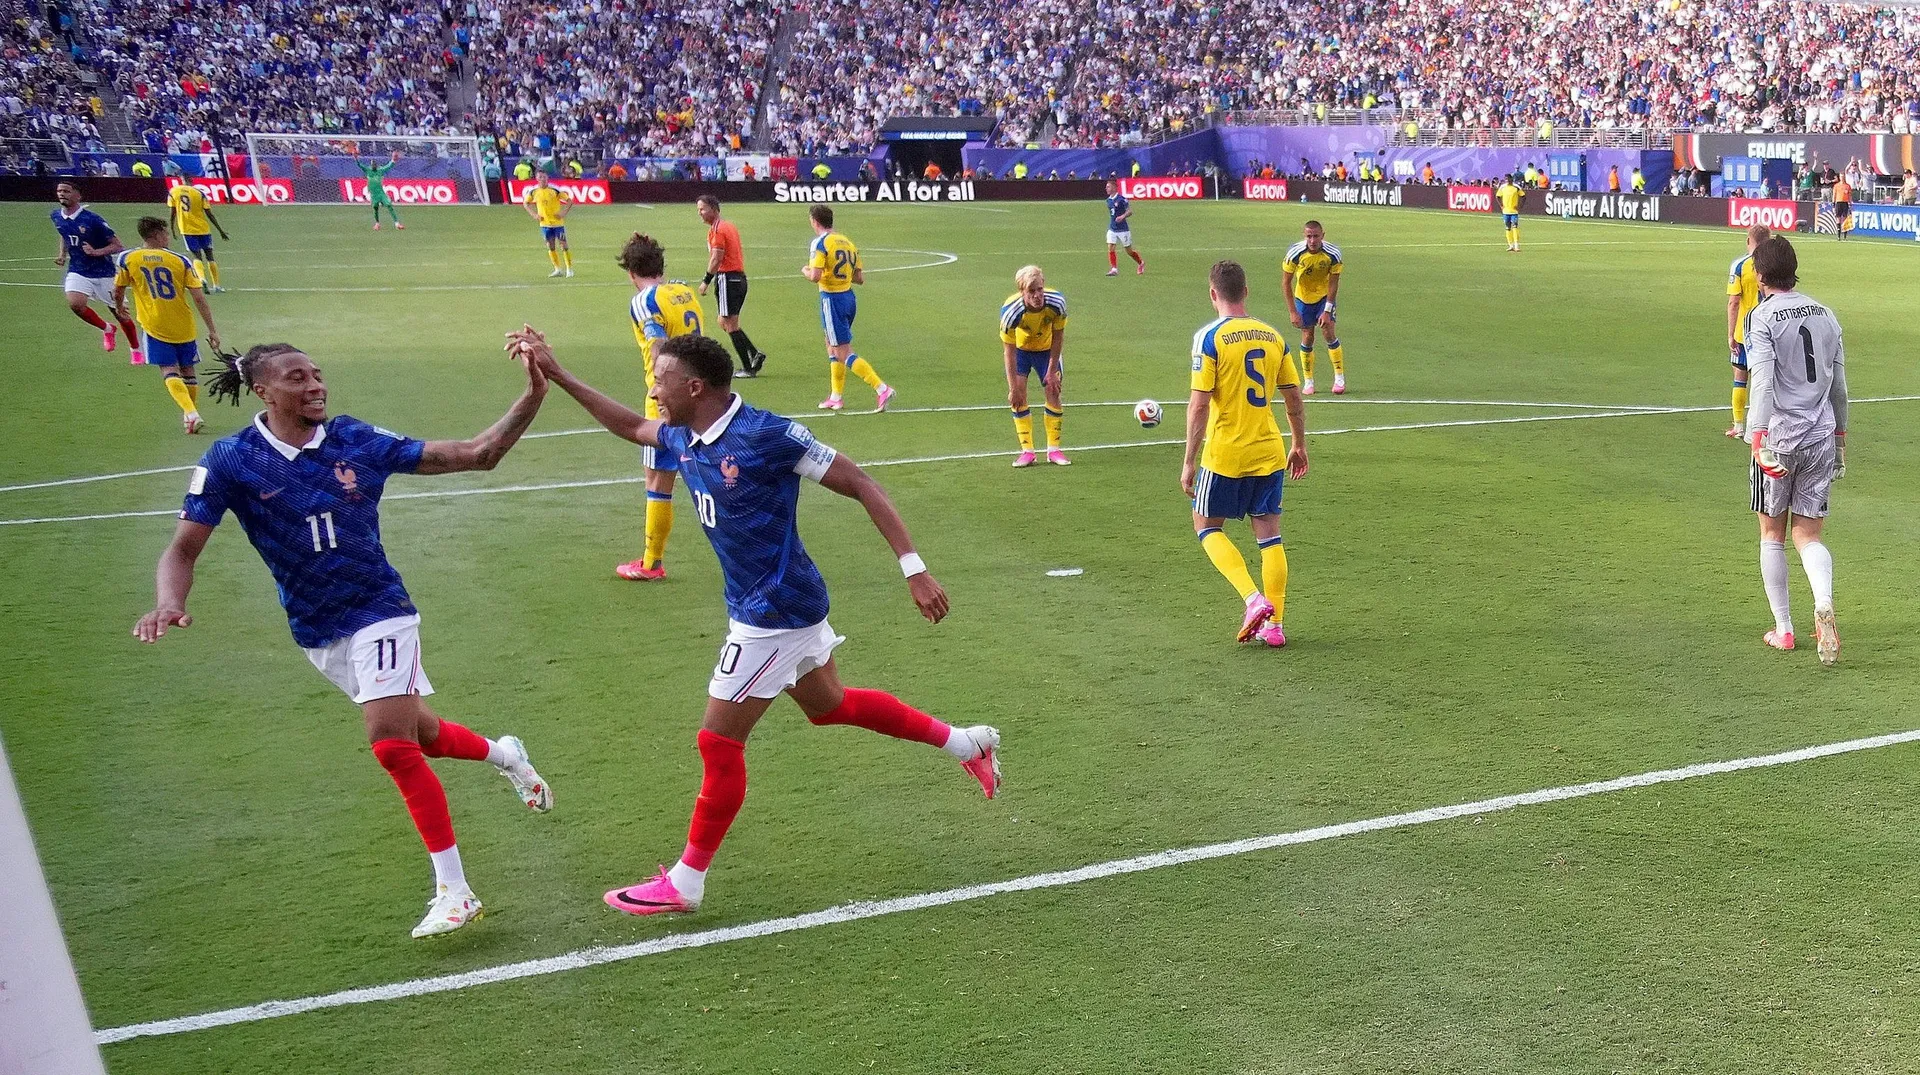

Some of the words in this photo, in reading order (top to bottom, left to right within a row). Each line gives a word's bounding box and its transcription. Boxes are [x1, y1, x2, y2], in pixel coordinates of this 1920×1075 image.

[1748, 143, 1806, 164] FRANCE
[1394, 160, 1415, 175] FIFA
[774, 182, 869, 202] Smarter
[876, 182, 901, 201] AI
[908, 181, 941, 201] for
[948, 181, 975, 201] all
[1120, 181, 1199, 198] Lenovo
[1246, 181, 1286, 199] Lenovo
[1324, 184, 1359, 203] Smarter
[1361, 185, 1371, 203] AI
[1373, 185, 1387, 205] for
[1390, 186, 1402, 206] all
[1449, 188, 1490, 210] Lenovo
[1545, 193, 1596, 218] Smarter
[1600, 196, 1614, 218] AI
[1618, 196, 1639, 219] for
[1642, 197, 1659, 220] all
[1731, 200, 1793, 229] Lenovo
[1851, 211, 1879, 230] FIFA
[68, 234, 80, 247] 17
[833, 249, 857, 279] 24
[140, 266, 176, 300] 18
[1798, 325, 1817, 383] 1
[1244, 348, 1267, 407] 5
[694, 490, 716, 528] 10
[305, 511, 337, 552] 11
[373, 638, 397, 671] 11
